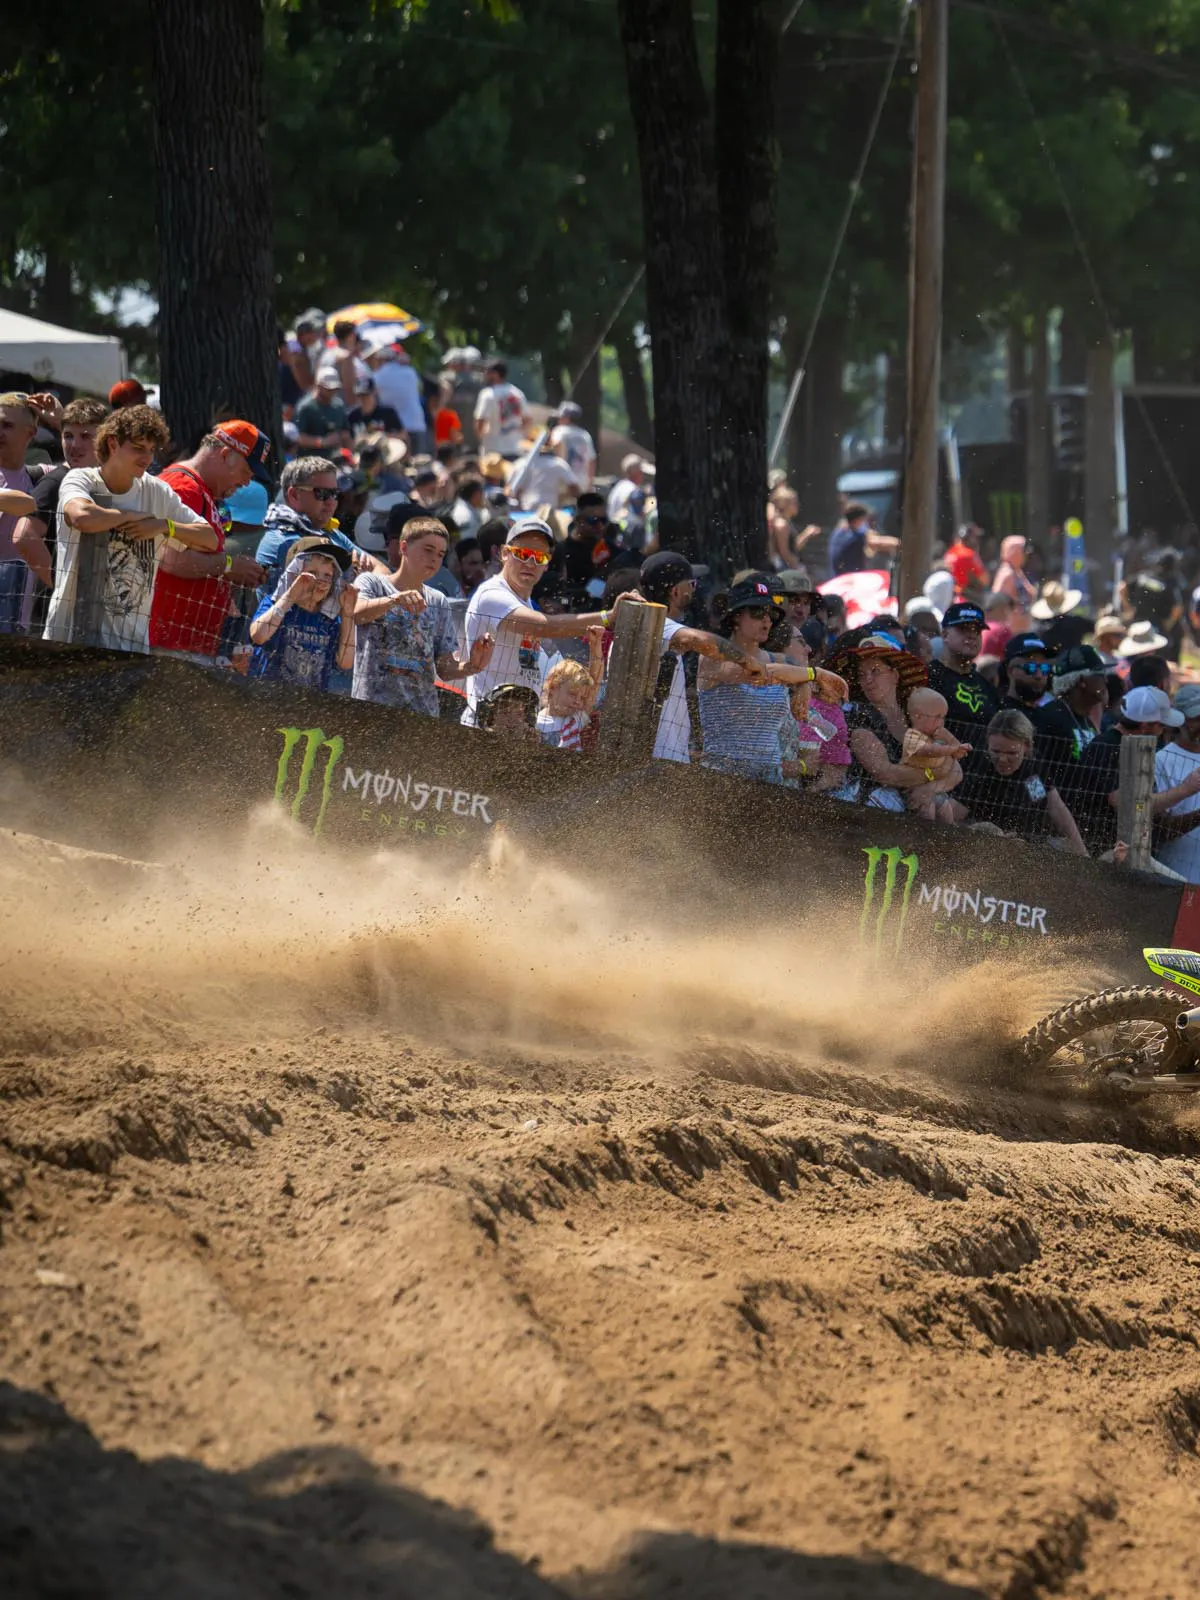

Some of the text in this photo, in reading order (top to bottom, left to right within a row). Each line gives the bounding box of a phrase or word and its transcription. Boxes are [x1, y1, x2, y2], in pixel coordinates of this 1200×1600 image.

[342, 767, 492, 824] MONSTER
[360, 808, 466, 838] ENERGY
[917, 882, 1049, 934] MONSTER
